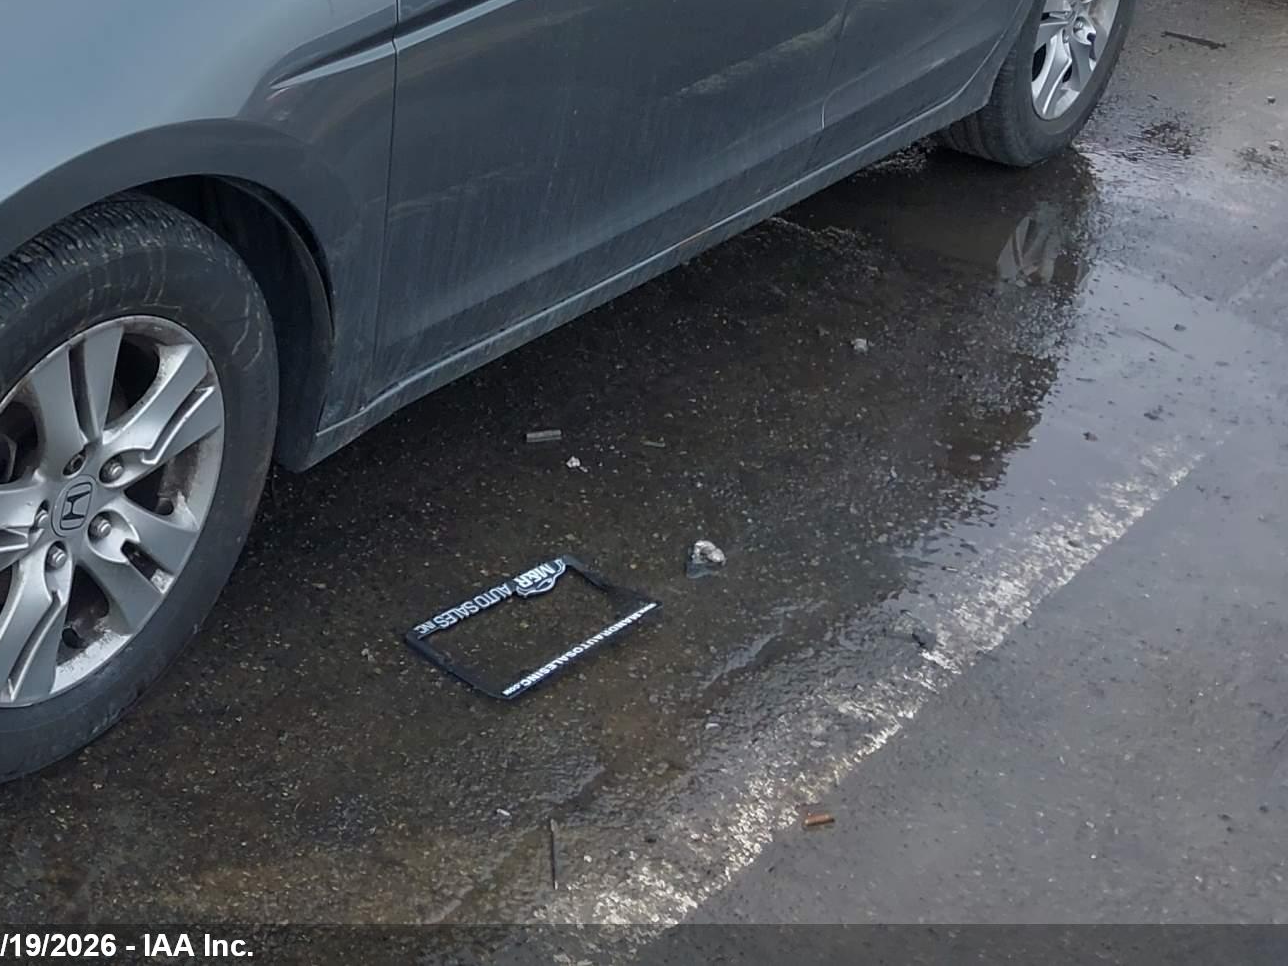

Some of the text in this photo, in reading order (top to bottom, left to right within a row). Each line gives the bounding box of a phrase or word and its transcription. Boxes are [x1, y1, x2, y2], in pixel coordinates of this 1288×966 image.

[513, 563, 555, 588] M&R
[473, 583, 513, 609] AUTO
[433, 600, 480, 629] SALES
